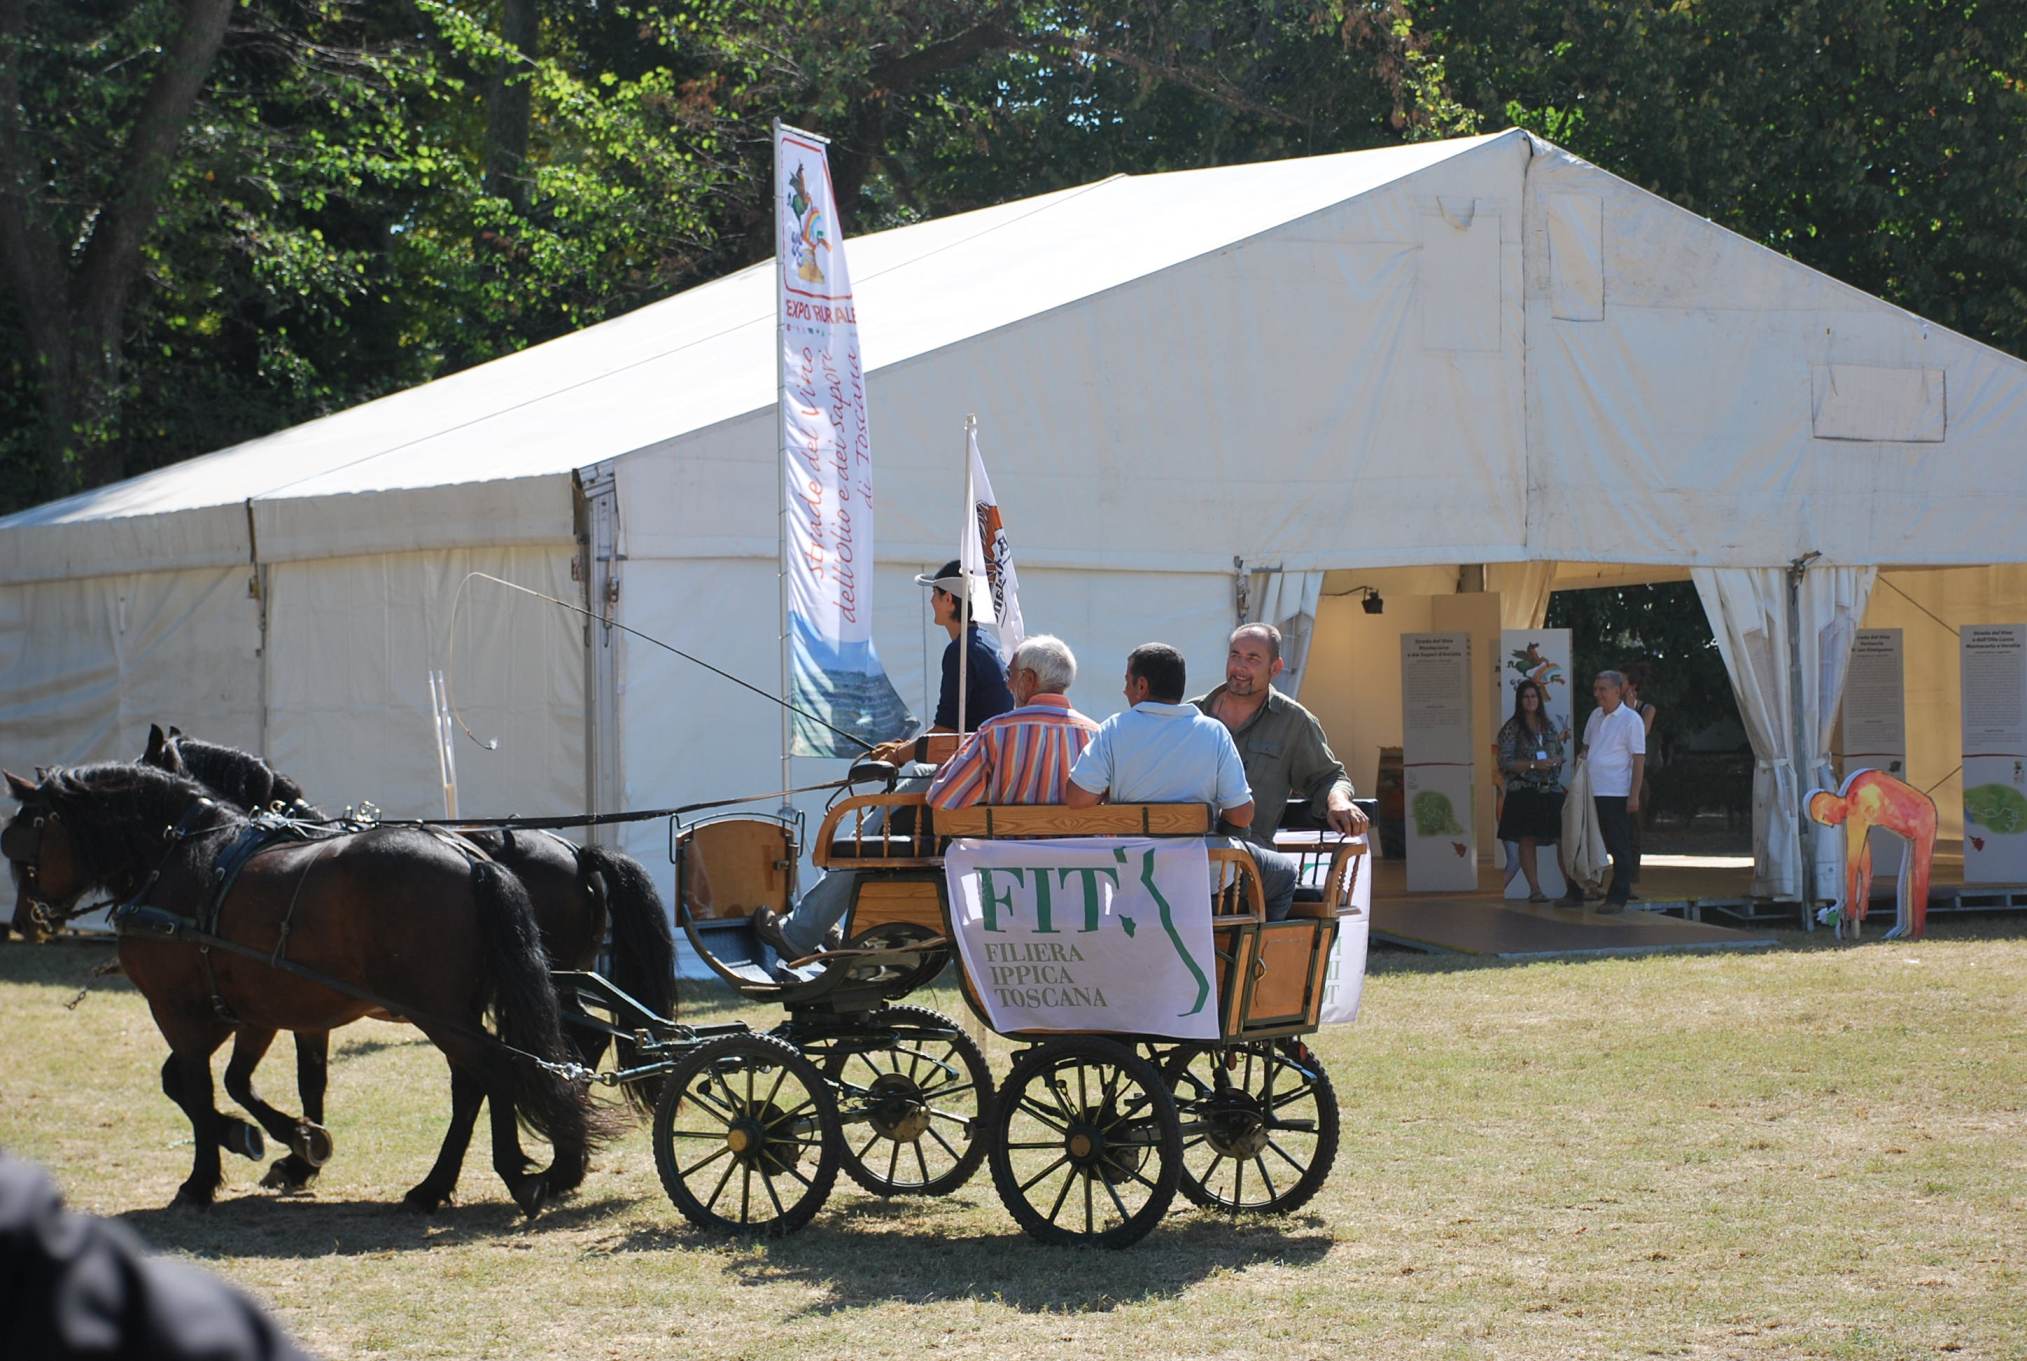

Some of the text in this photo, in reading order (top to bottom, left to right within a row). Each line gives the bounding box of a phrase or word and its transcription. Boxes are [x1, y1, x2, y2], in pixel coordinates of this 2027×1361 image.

[786, 300, 857, 324] EXPO RURALE
[797, 347, 819, 416] Vino
[801, 427, 820, 472] del
[828, 440, 849, 481] dei
[839, 489, 850, 502] e
[857, 481, 873, 509] di
[973, 867, 1120, 933] FIT
[985, 943, 1085, 962] FILIERA
[989, 965, 1074, 985] IPPICA
[995, 987, 1108, 1008] TOSCANA
